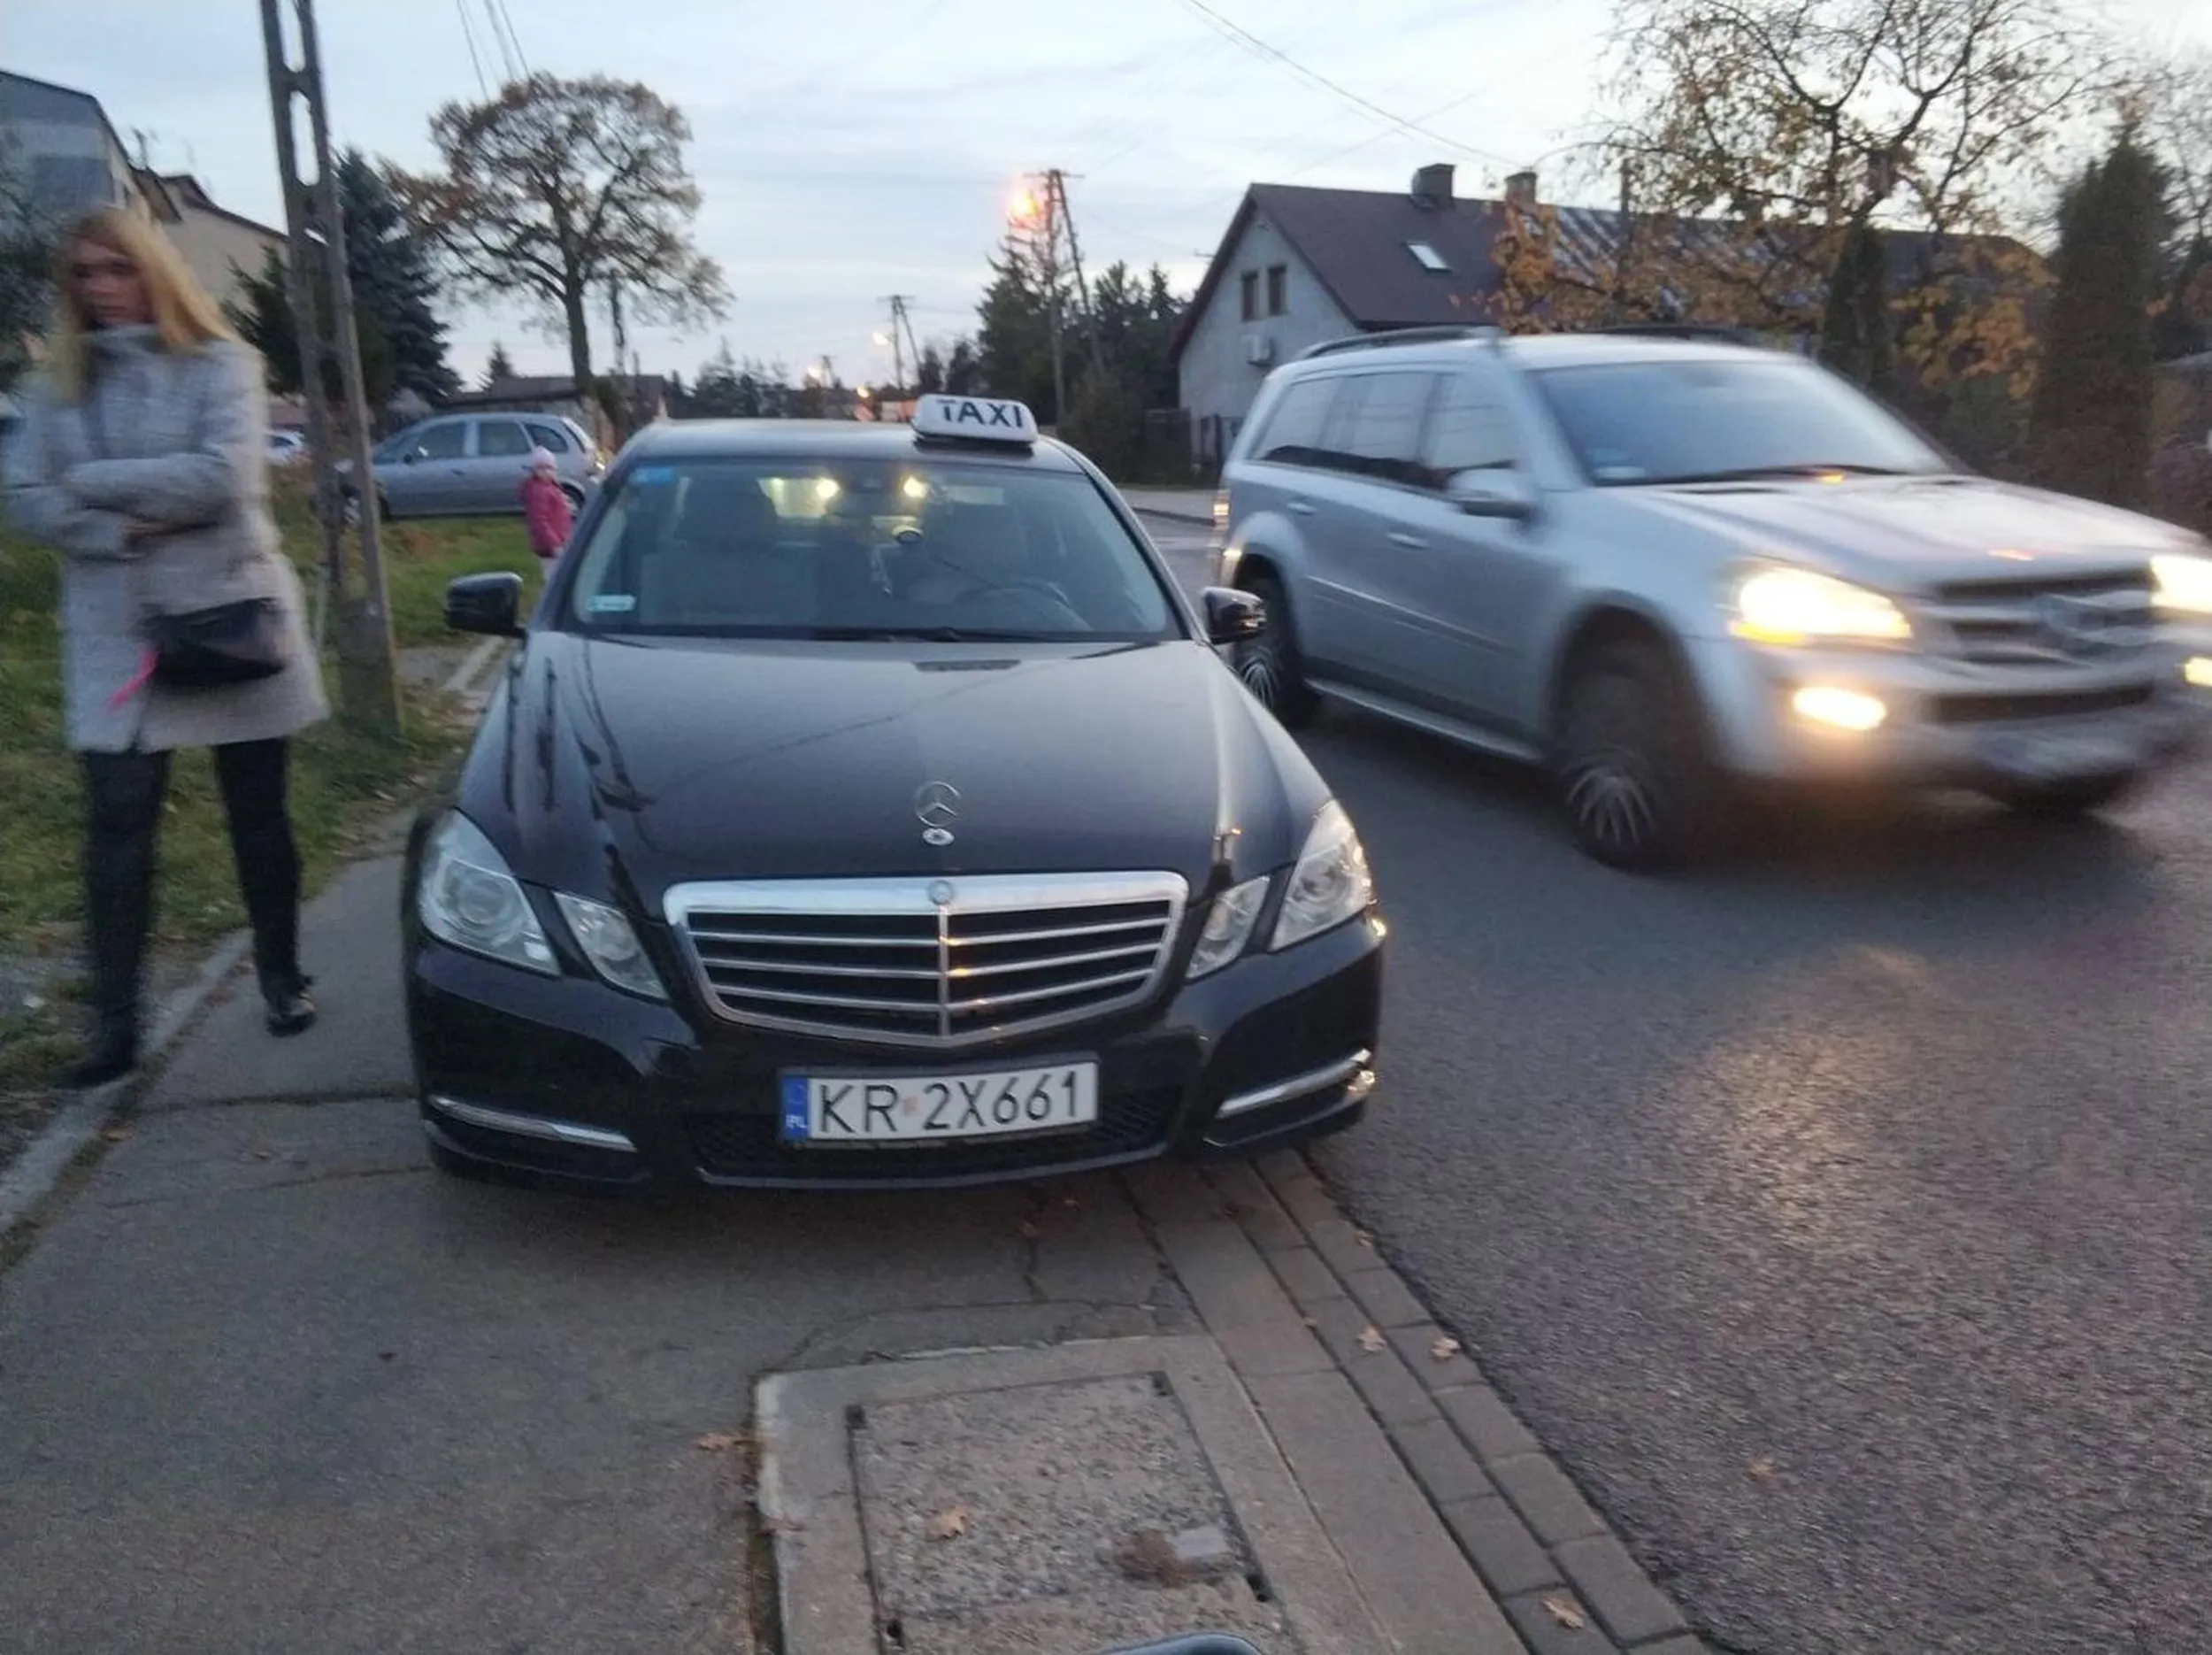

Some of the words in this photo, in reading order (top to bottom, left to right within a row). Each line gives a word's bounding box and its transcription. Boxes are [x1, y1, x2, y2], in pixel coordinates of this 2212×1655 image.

[936, 398, 1023, 427] TAXI
[818, 1083, 899, 1134] KR
[923, 1070, 1077, 1131] 2X661
